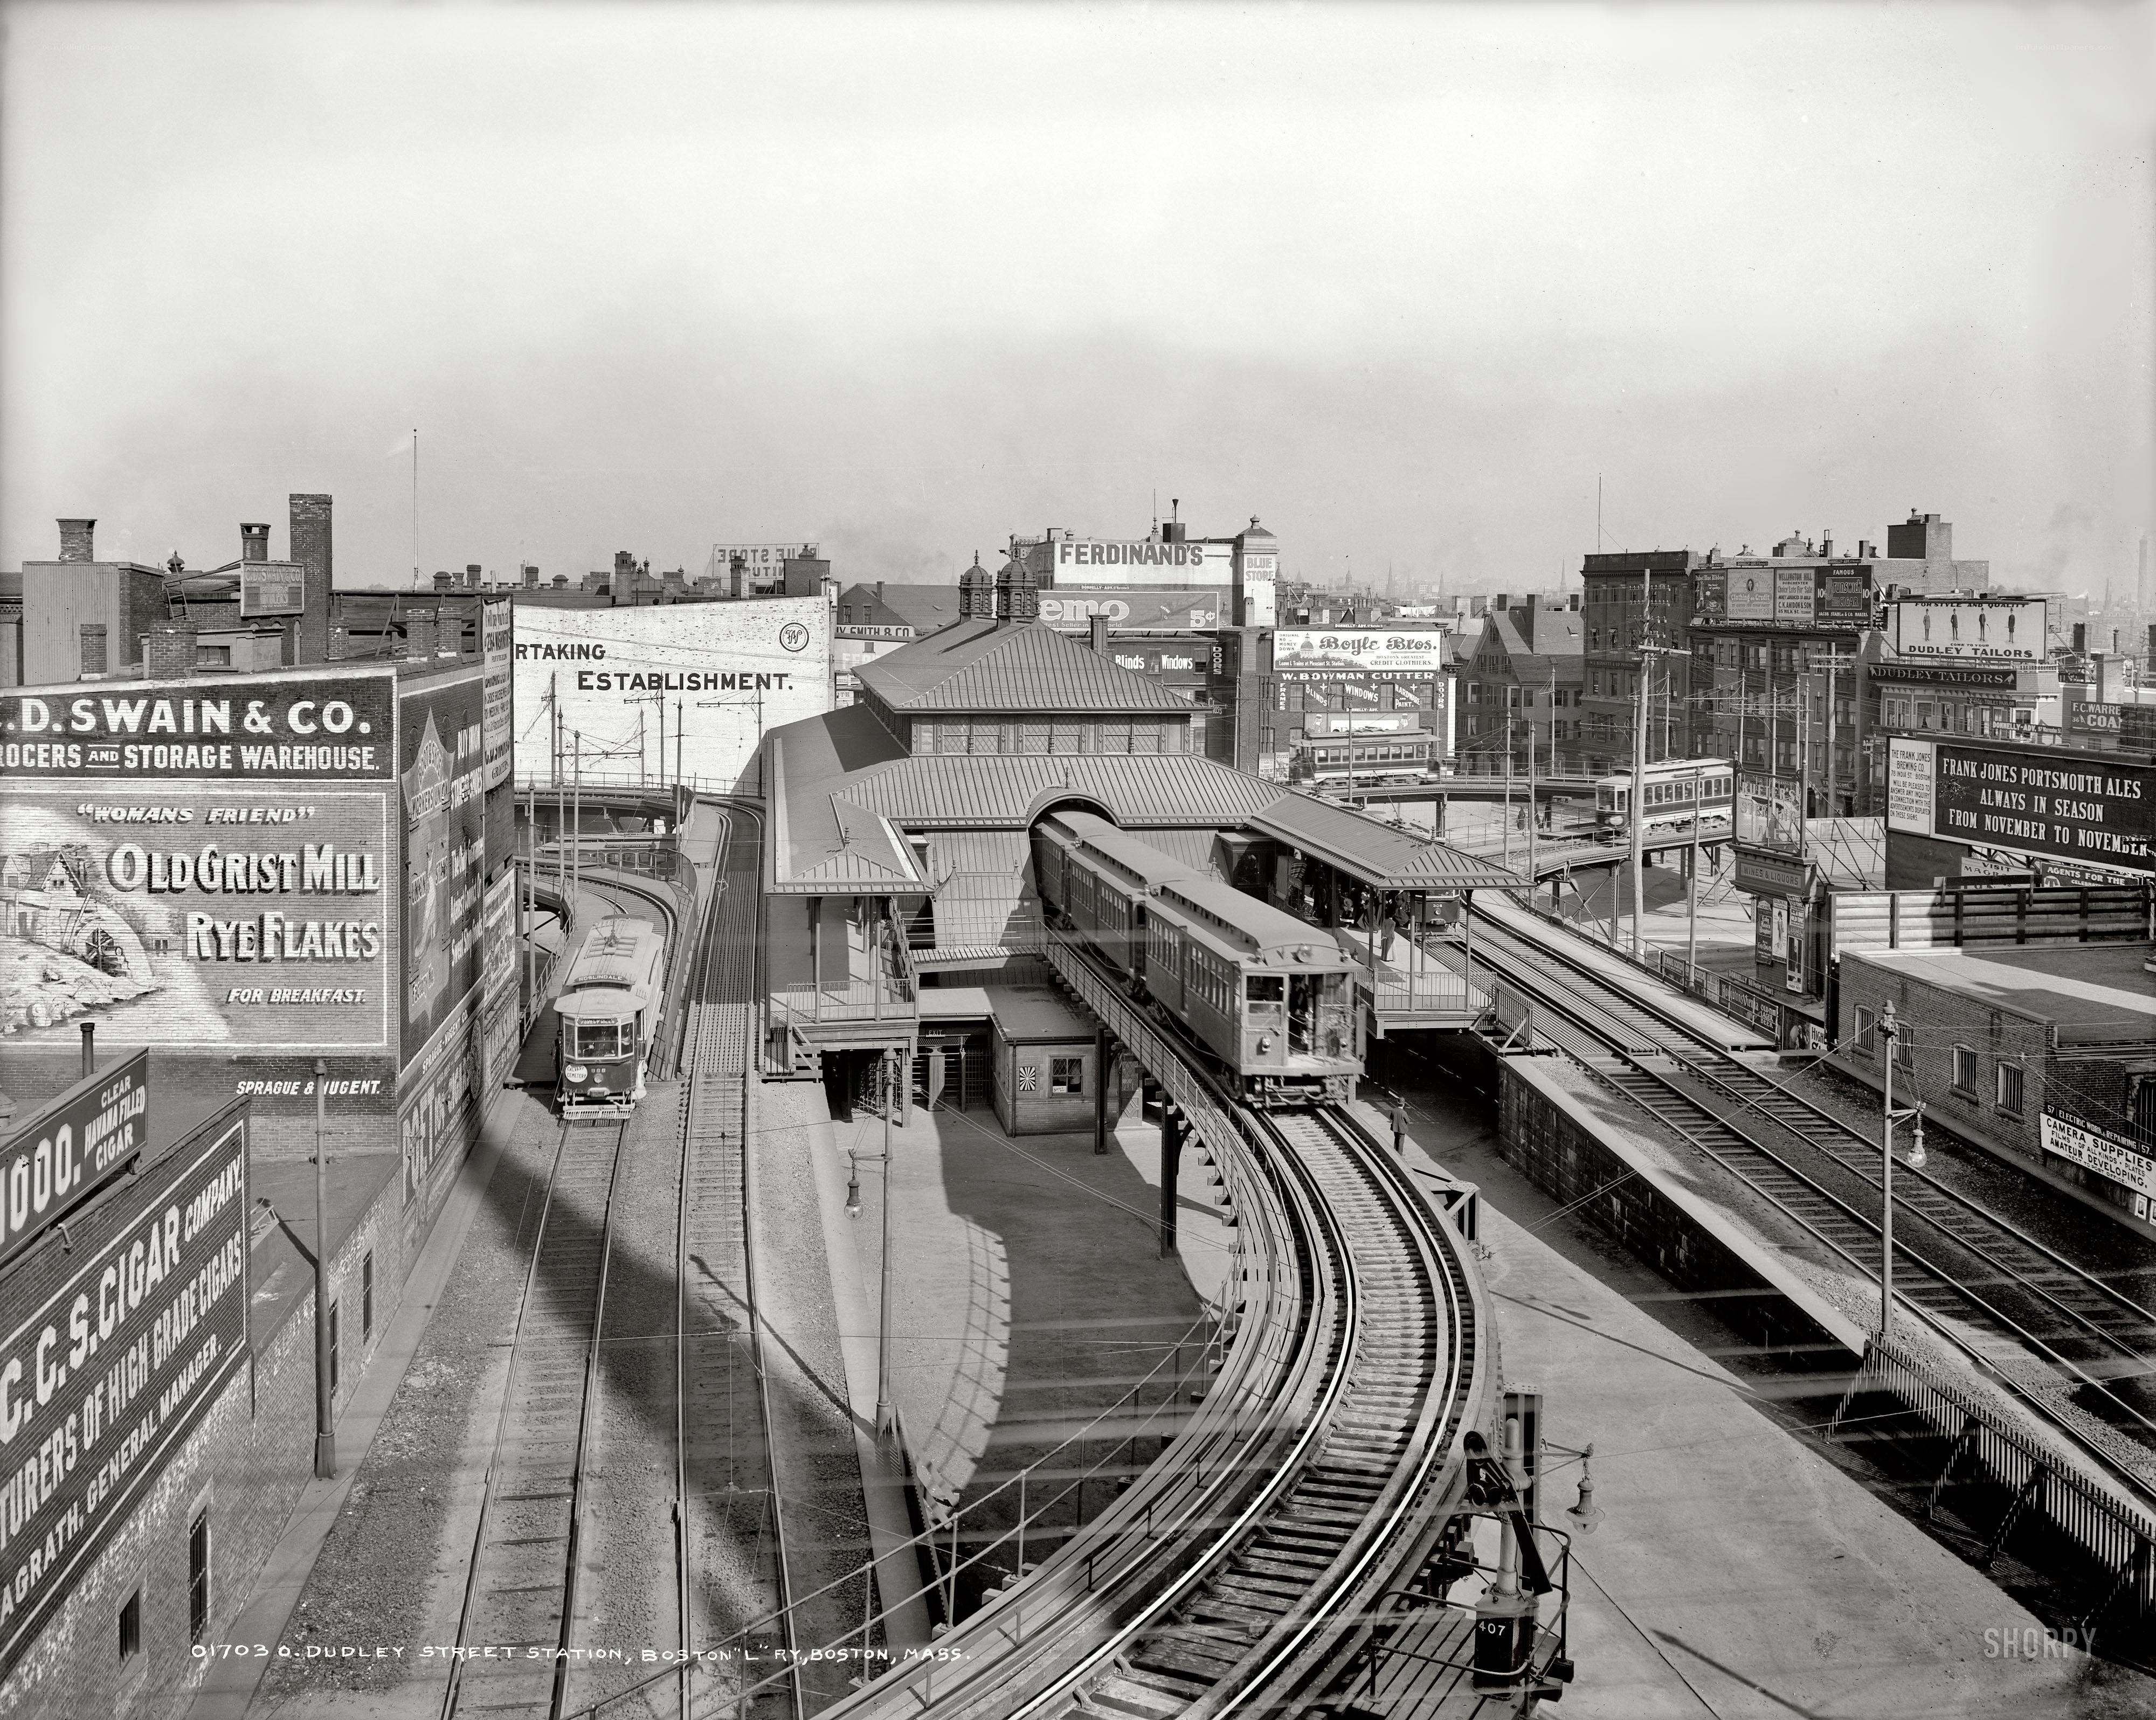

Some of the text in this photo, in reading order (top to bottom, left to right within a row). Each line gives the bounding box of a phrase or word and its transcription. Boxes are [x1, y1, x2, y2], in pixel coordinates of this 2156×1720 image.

[1060, 543, 1203, 566] FERDINAND'S
[1247, 557, 1272, 568] BLUE
[1246, 570, 1274, 581] STORE
[1779, 573, 1802, 581] WELLINGTON
[1839, 597, 1858, 607] CIGAR
[515, 643, 606, 661] RTAKING
[1319, 635, 1437, 656] Boyle Bros.
[1909, 645, 2033, 658] DUDLEY TAILORS
[1115, 654, 1193, 670] Blinds Windows
[1213, 647, 1222, 675] DOORS
[578, 671, 793, 691] ESTABLISHMENT.
[1878, 667, 2003, 684] DUDLEY TAILORS
[1305, 684, 1328, 706] BLINDS
[1345, 683, 1379, 703] WINDOWS
[1395, 683, 1420, 705] HARDWARE
[1395, 698, 1414, 709] PAINT.
[2073, 703, 2088, 713] F.C.
[0, 699, 371, 734] .D. SWAIN & CO.
[458, 723, 481, 760] BUY UNION
[88, 749, 119, 764] AND
[125, 744, 232, 769] STORAGE
[240, 746, 380, 771] WAREHOUSE.
[1900, 750, 1915, 761] FRANK
[1916, 752, 1931, 762] JONES
[1897, 760, 1917, 772] BREWING
[1908, 782, 1924, 791] PLEASED
[1943, 758, 2141, 800] FRANK JONES PORTSMOUTH ALES
[1890, 787, 1905, 795] ANSWER
[1915, 791, 1930, 800] INQUIRY
[1894, 795, 1915, 805] CONNECTION
[1890, 803, 1930, 815] ADVERTISEMENTS DISPLAYED
[1980, 788, 2104, 823] ALWAYS IN SEASON
[1896, 811, 1905, 819] THESE
[1906, 813, 1919, 821] SIGNS.
[108, 843, 381, 896] OLD GRIST MILL
[1743, 866, 1799, 885] WINES & LIQUORS
[1982, 863, 2011, 872] VISIT
[2048, 867, 2125, 886] AGENTS FOR THE
[185, 911, 381, 962] RYE FLAKES
[227, 988, 366, 1005] FOR BREAKFAST.
[1760, 1012, 1773, 1022] LAGER
[1760, 1018, 1773, 1029] BEER
[1812, 1027, 1824, 1044] HIGH
[101, 1075, 132, 1108] CLEAR
[236, 1080, 300, 1095] SPRAGUE
[303, 1080, 314, 1094] &
[84, 1085, 146, 1155] HAVANA FILLED
[95, 1122, 134, 1171] CIGAR
[2047, 1118, 2153, 1171] CAMERA SUPPLIES
[2051, 1131, 2070, 1143] FILMS
[2087, 1146, 2097, 1155] ALL
[2098, 1151, 2117, 1164] KINDS
[2125, 1163, 2145, 1177] PLATES
[2050, 1138, 2148, 1189] AMATEUR DEVELOPING.
[2068, 1154, 2082, 1163] NEXT
[2091, 1164, 2104, 1173] POST
[2106, 1172, 2125, 1184] OFFICE
[99, 1204, 180, 1341] CIGAR
[184, 1154, 243, 1242] COMPANY.
[83, 1384, 103, 1451] OF
[107, 1333, 148, 1426] HIGH
[153, 1279, 198, 1371] GRADE
[199, 1230, 242, 1317] CIGARS
[1478, 1621, 1506, 1636] 407
